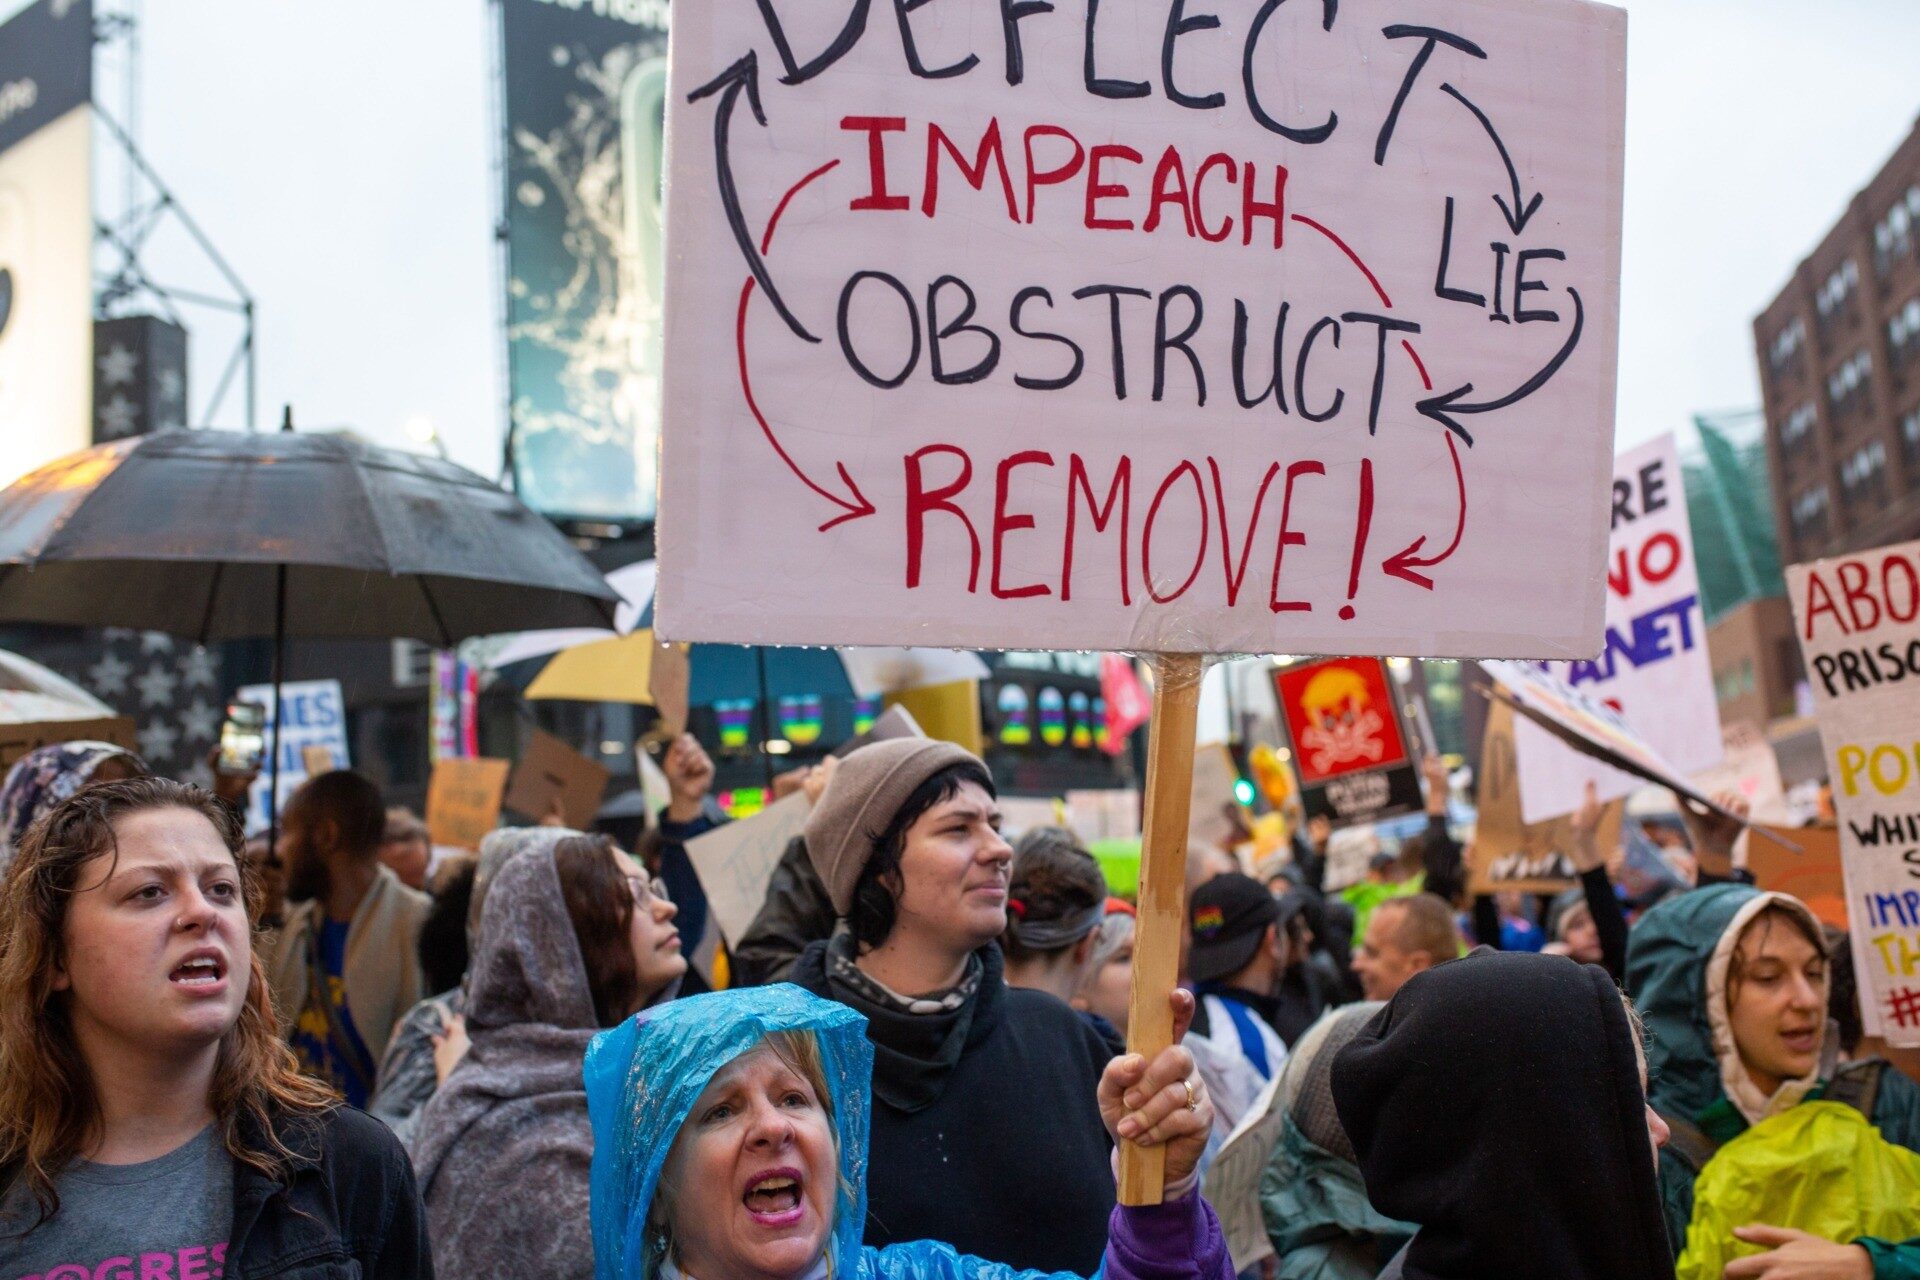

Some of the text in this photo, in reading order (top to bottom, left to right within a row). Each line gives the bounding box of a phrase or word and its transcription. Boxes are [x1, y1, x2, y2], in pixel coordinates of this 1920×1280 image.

[840, 115, 1289, 249] IMPEACH
[1434, 195, 1566, 324] LIE
[836, 270, 1420, 435] OBSTRUCT
[903, 444, 1373, 620] REMOVE!
